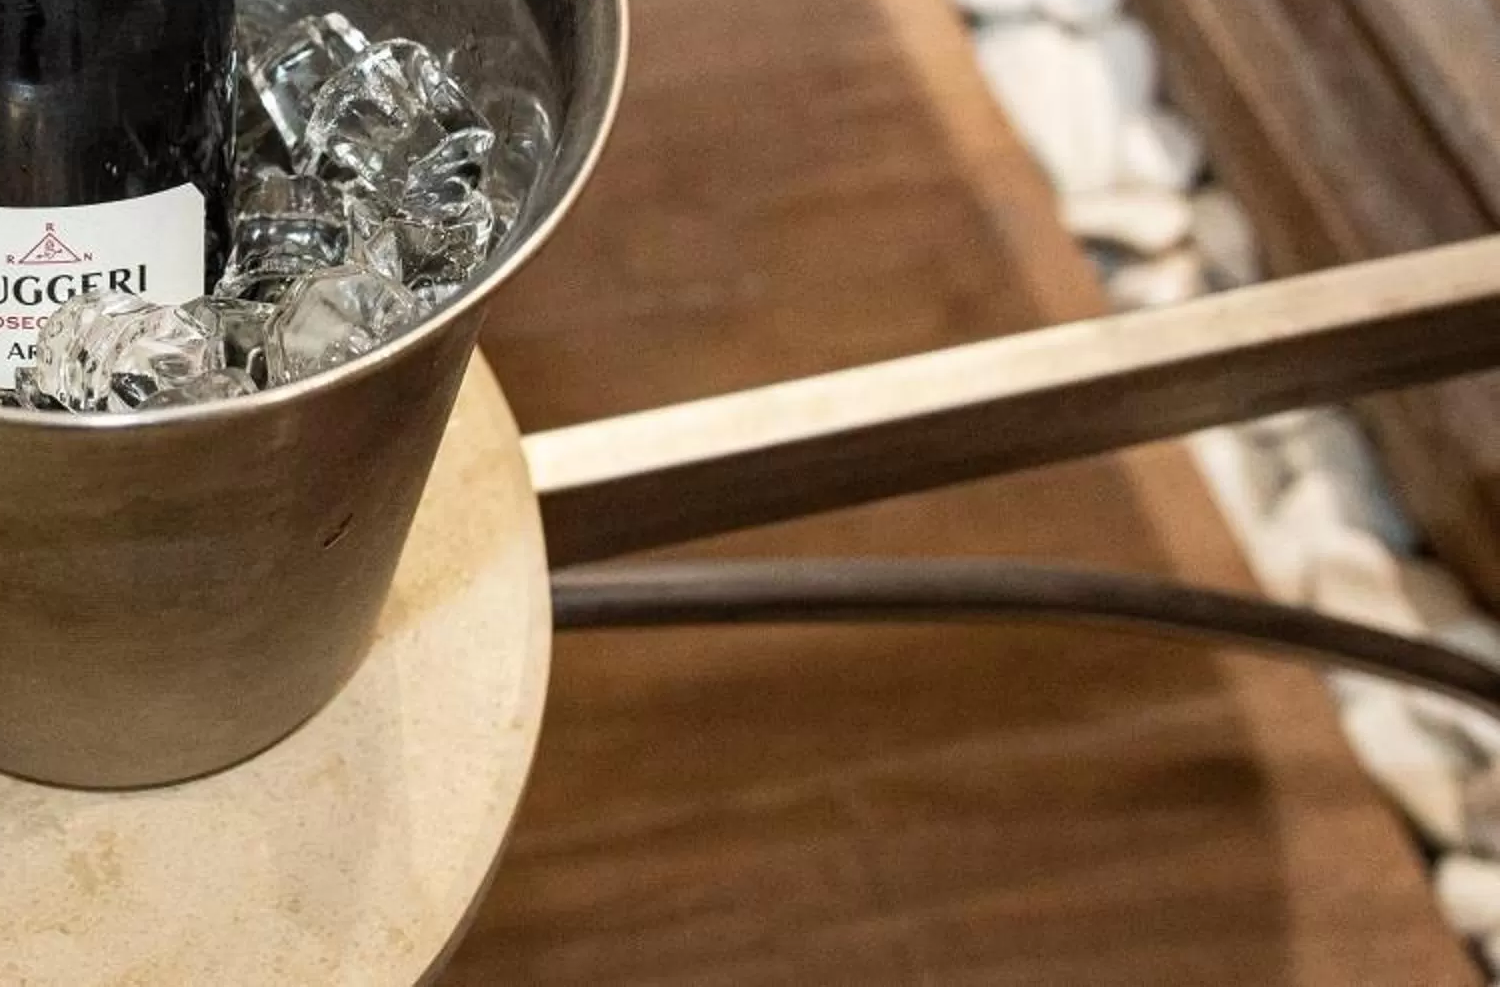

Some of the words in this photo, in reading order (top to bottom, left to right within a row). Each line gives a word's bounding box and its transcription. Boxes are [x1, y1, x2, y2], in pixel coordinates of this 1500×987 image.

[45, 222, 55, 232] R
[6, 254, 15, 265] R
[83, 252, 93, 261] N
[7, 342, 37, 360] AR
